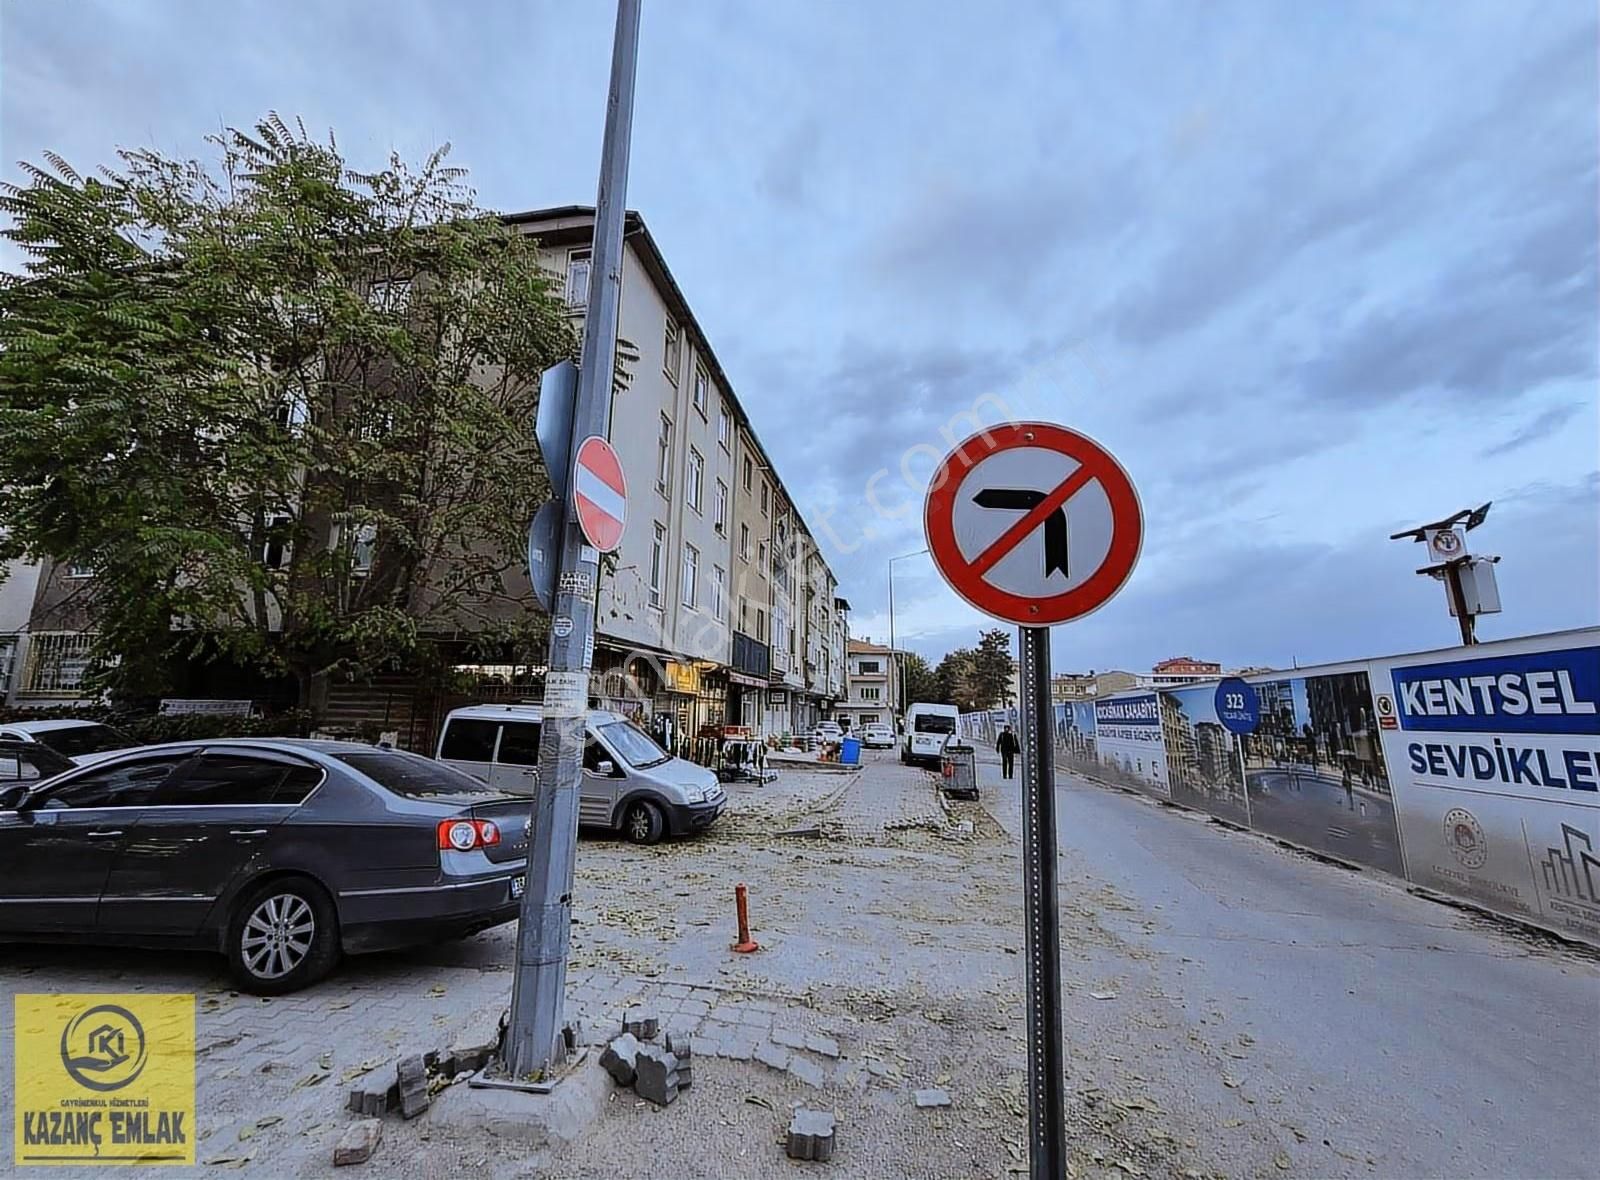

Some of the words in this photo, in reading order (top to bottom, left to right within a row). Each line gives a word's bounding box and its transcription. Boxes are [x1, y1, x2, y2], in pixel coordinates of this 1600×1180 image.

[1226, 693, 1244, 709] 323
[1400, 670, 1596, 715] KENTSEL
[1408, 737, 1600, 792] SEVDİKLE
